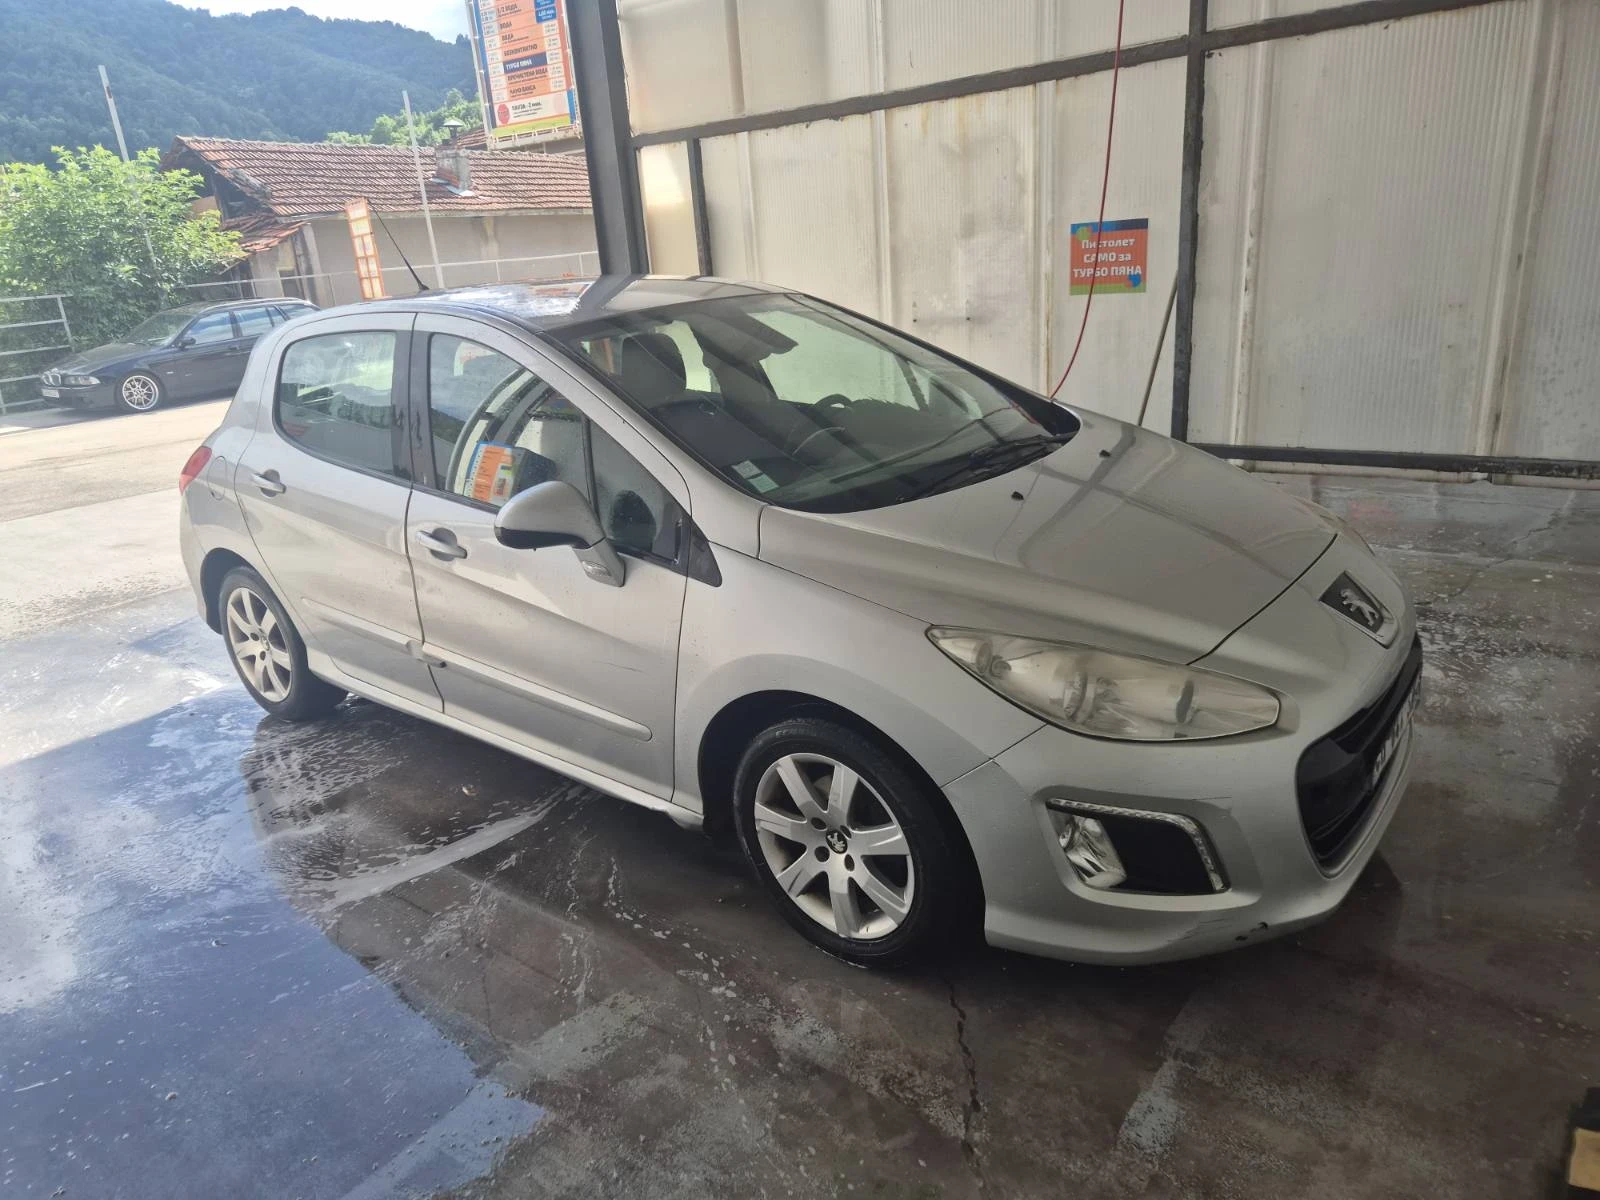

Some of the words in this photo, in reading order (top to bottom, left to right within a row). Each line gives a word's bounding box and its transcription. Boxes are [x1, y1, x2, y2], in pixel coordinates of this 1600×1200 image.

[1081, 238, 1136, 249] Пистолет
[1083, 252, 1117, 263] САМО
[1118, 253, 1132, 262] за
[1073, 267, 1108, 278] ТУРБО
[1110, 265, 1142, 276] ПЯНА
